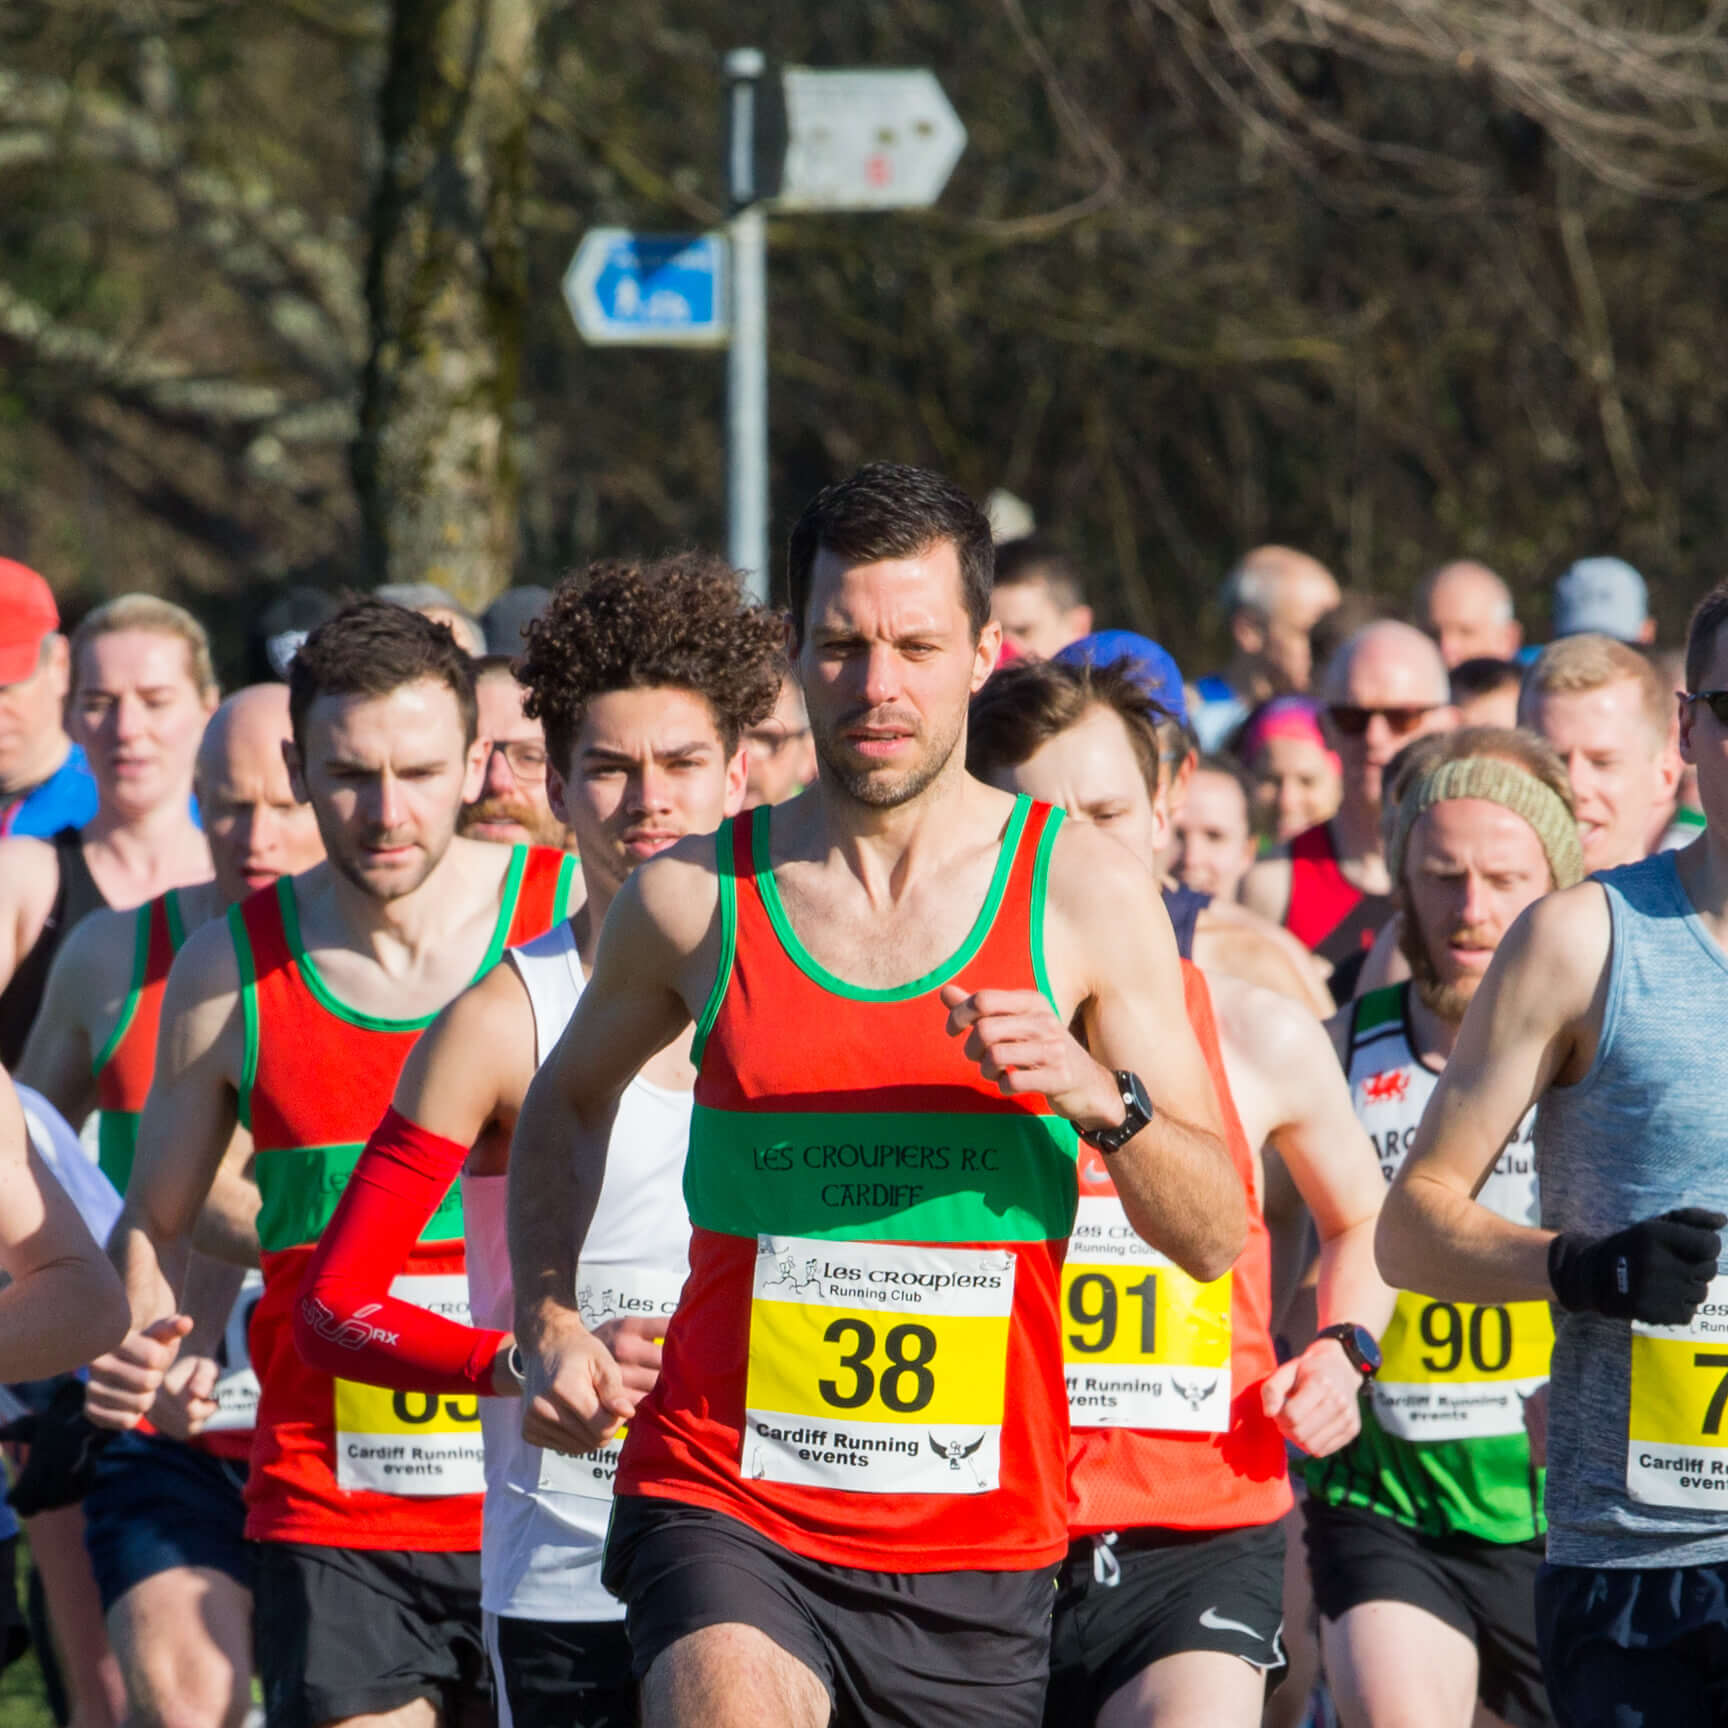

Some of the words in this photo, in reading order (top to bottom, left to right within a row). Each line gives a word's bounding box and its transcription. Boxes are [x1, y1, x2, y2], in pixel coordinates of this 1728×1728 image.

[753, 1146, 794, 1171] LES
[803, 1144, 950, 1170] CROUPIERS
[821, 1183, 924, 1207] CARDIFF
[1074, 1242, 1125, 1255] Running
[830, 1285, 887, 1302] Running
[891, 1290, 922, 1303] Club
[1068, 1273, 1157, 1354] 91
[1420, 1302, 1512, 1373] 90
[818, 1317, 937, 1414] 38
[1086, 1378, 1162, 1396] Running
[1069, 1395, 1118, 1407] vents
[756, 1424, 827, 1446] Cardiff
[834, 1433, 919, 1456] Running
[348, 1445, 405, 1460] Cardiff
[412, 1447, 484, 1462] Running
[798, 1449, 870, 1467] events
[383, 1462, 443, 1475] events
[1639, 1454, 1704, 1473] Cardiff
